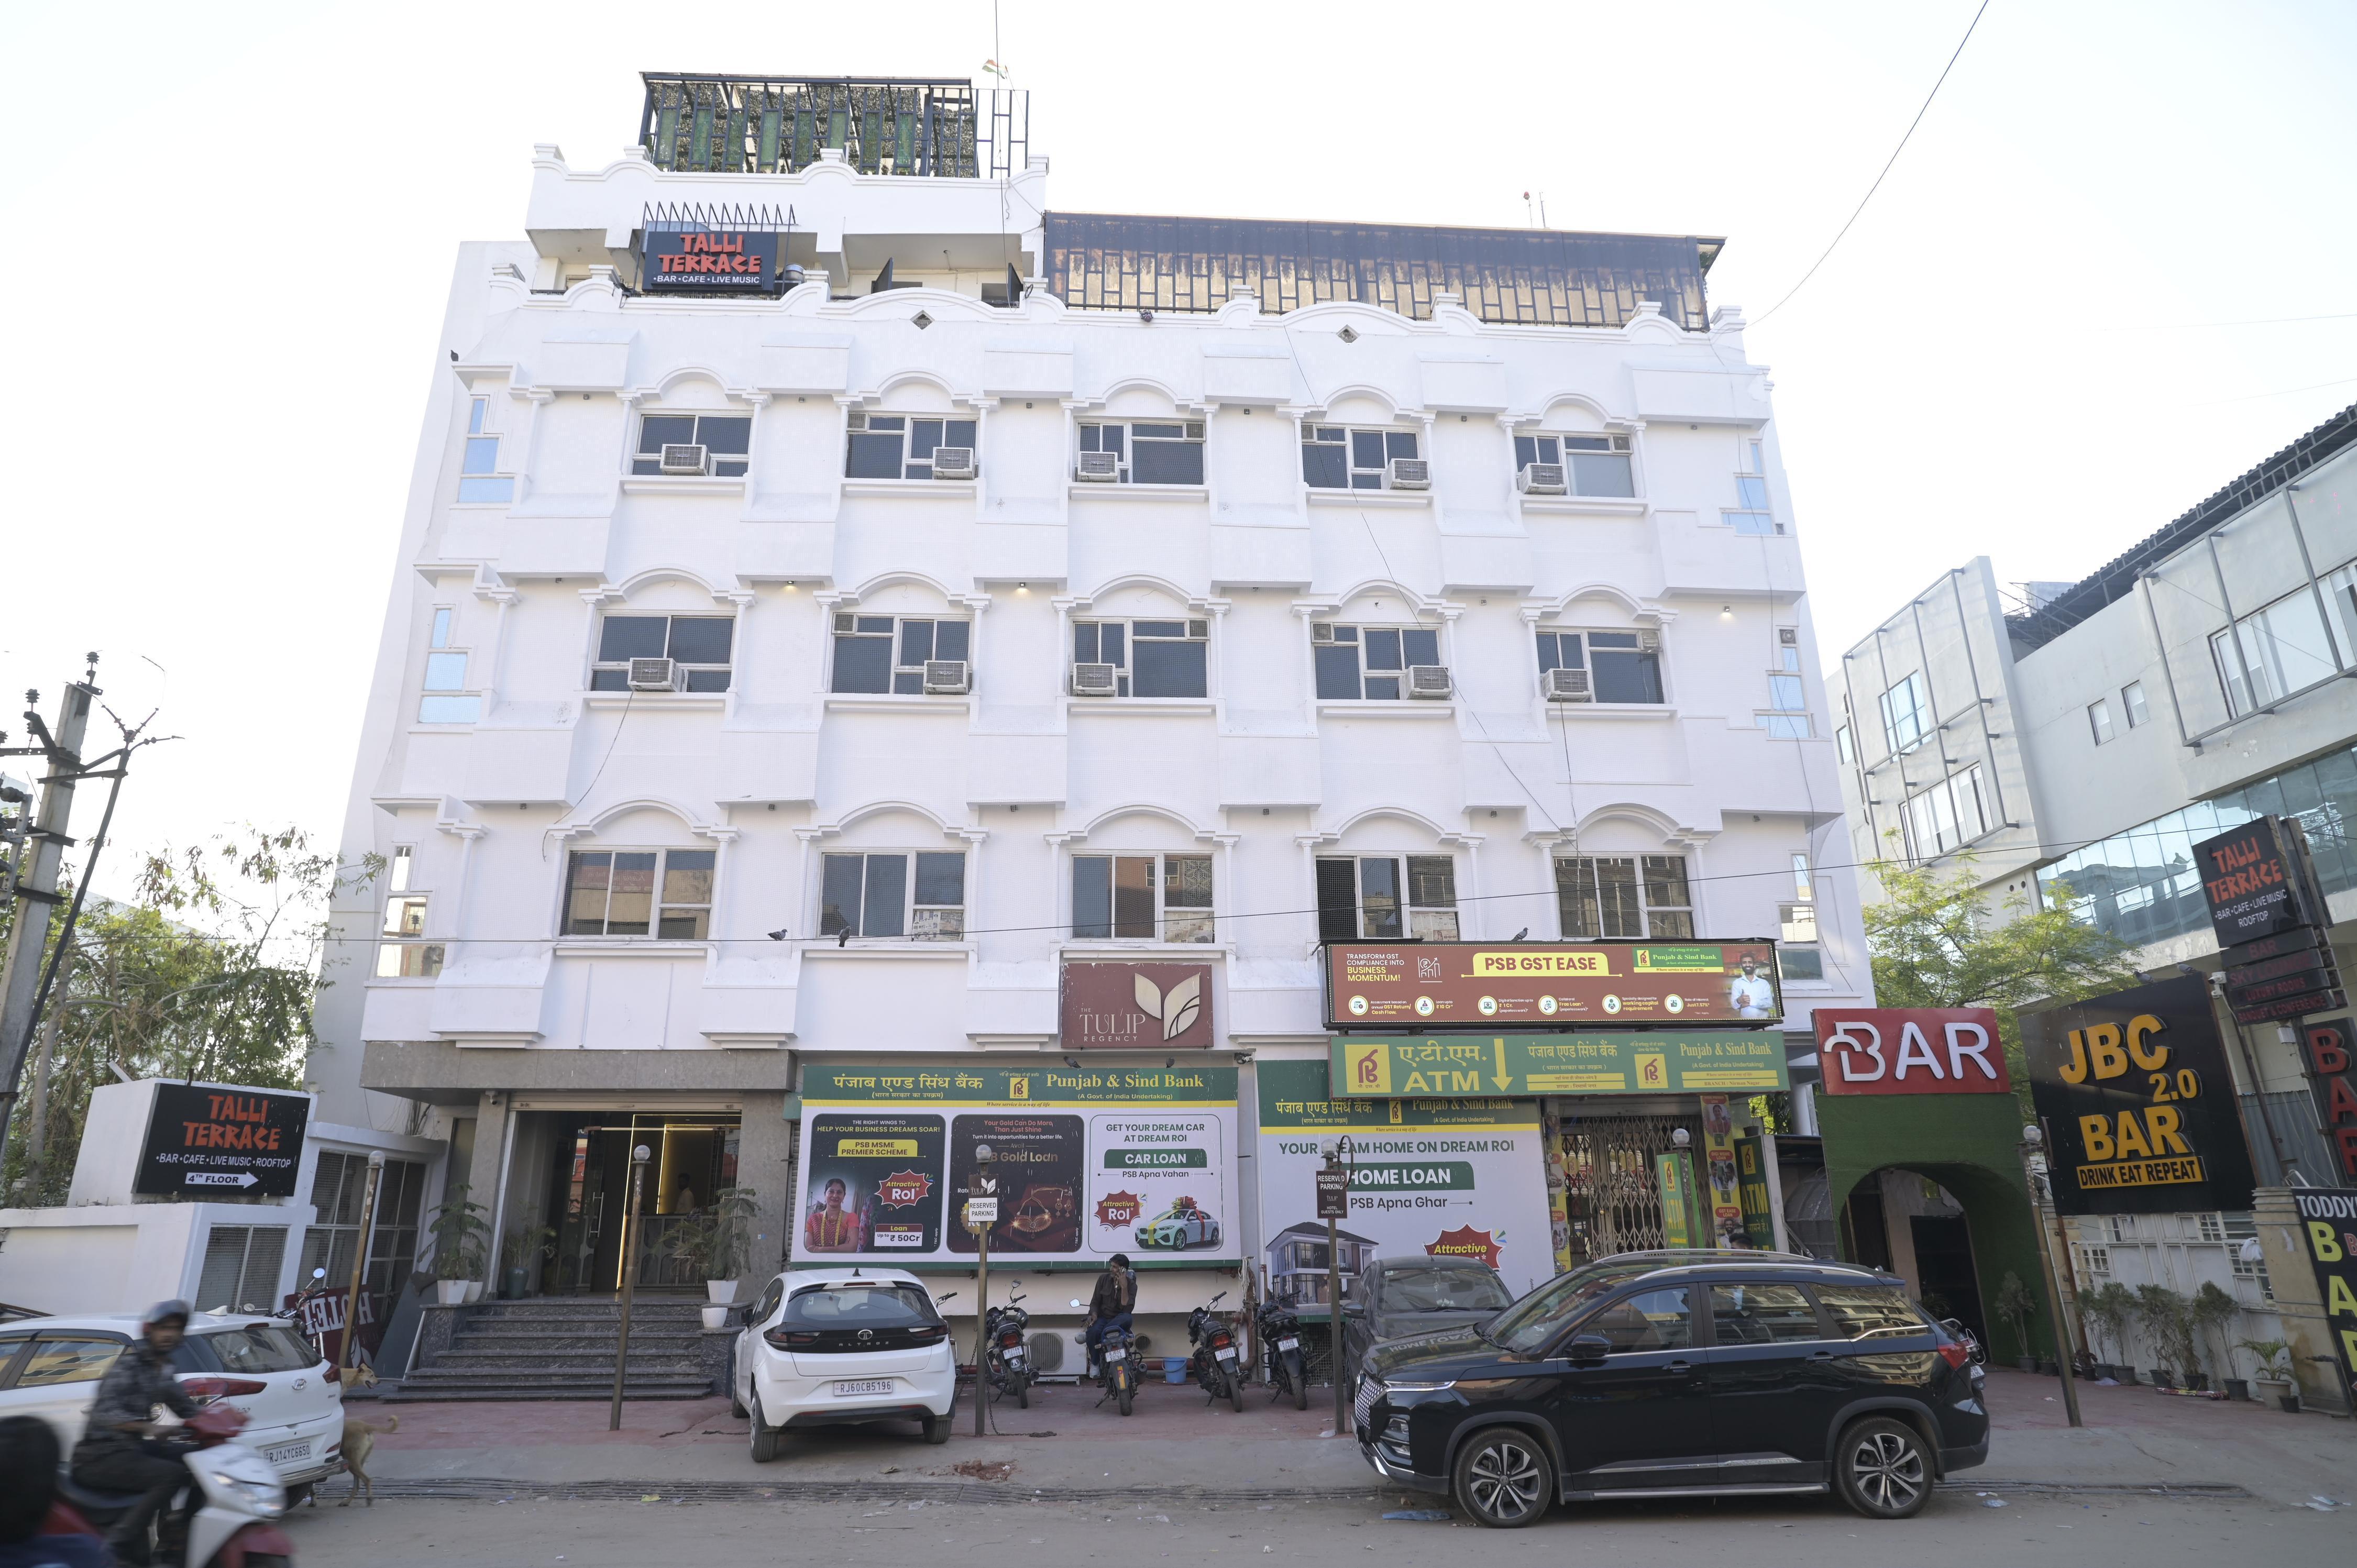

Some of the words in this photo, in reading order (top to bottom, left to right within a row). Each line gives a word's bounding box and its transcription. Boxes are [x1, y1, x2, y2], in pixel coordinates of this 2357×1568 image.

[680, 233, 743, 253] TALLI
[658, 254, 761, 273] TERRACE
[2211, 837, 2262, 874] TALLI
[2206, 859, 2283, 904] TERRACE
[2217, 908, 2231, 920] BAR
[2233, 902, 2250, 916] CAFE
[2252, 896, 2267, 908] LIVE
[2266, 889, 2287, 904] MUSIC
[2238, 911, 2269, 928] ROOFTOP
[2249, 940, 2277, 958] BAR
[1484, 957, 1517, 970] PSB
[1521, 957, 1552, 970] GST
[1556, 957, 1597, 970] EASE
[2230, 969, 2255, 986] SKY
[2257, 953, 2313, 978] LOUNGE
[2245, 986, 2275, 1001] LUXURY
[2277, 978, 2306, 992] ROOMS
[2238, 1007, 2268, 1022] BANQUET
[2277, 996, 2327, 1014] CONFERENCE
[1079, 1012, 1146, 1034] TULIP
[1396, 1040, 1487, 1067] ए.टी.एम.
[1527, 1042, 1555, 1058] पंजाब
[1556, 1045, 1576, 1062] एण्ड
[1577, 1041, 1598, 1058] सिंध
[1599, 1039, 1617, 1057] बैंक
[1680, 1043, 1712, 1059] Punjab
[1715, 1043, 1723, 1056] &
[1726, 1042, 1746, 1055] Sind
[1747, 1042, 1772, 1055] Bank
[1824, 1021, 1998, 1081] BAR
[2058, 1014, 2171, 1084] JBC
[833, 1073, 877, 1089] पंजाब
[880, 1077, 915, 1092] एण्ड
[918, 1073, 951, 1089] सिंध
[954, 1072, 984, 1089] बैंक
[1047, 1074, 1102, 1090] Punjab
[1106, 1074, 1120, 1087] &
[1125, 1074, 1159, 1088] Sind
[1164, 1074, 1204, 1088] Bank
[1403, 1070, 1480, 1092] ATM
[2149, 1068, 2200, 1102] 2.0
[207, 1095, 269, 1123] TALLI
[182, 1121, 281, 1150] TERRACE
[2079, 1105, 2192, 1161] BAR
[1000, 1152, 1028, 1162] Gold
[1030, 1152, 1059, 1162] Loan
[1279, 1143, 1318, 1155] YOUR
[1373, 1141, 1414, 1154] HOME
[1416, 1141, 1437, 1153] ON
[1440, 1140, 1489, 1153] DREAM
[1491, 1140, 1515, 1152] ROI
[183, 1154, 205, 1165] CAFE
[210, 1155, 227, 1165] LIVE
[227, 1155, 251, 1167] MUSIC
[256, 1157, 291, 1168] ROOFTOP
[1125, 1153, 1151, 1164] CAR
[1153, 1153, 1187, 1164] LOAN
[188, 1174, 203, 1183] 4TH
[205, 1175, 239, 1184] FLOOR
[1139, 1171, 1160, 1179] Apna
[1347, 1169, 1399, 1185] HOME
[1403, 1168, 1451, 1184] LOAN
[2079, 1166, 2118, 1186] DRINK
[2119, 1164, 2142, 1183] EAT
[2146, 1159, 2196, 1182] REPEAT
[1350, 1198, 1374, 1209] PSB
[1376, 1197, 1412, 1212] Apna
[1415, 1196, 1448, 1208] Ghar
[1742, 1183, 1769, 1216] ATM
[1434, 1243, 1488, 1254] Attractive
[840, 1381, 891, 1393] RJ60CB5196
[269, 1445, 310, 1463] RJ14YC6650
